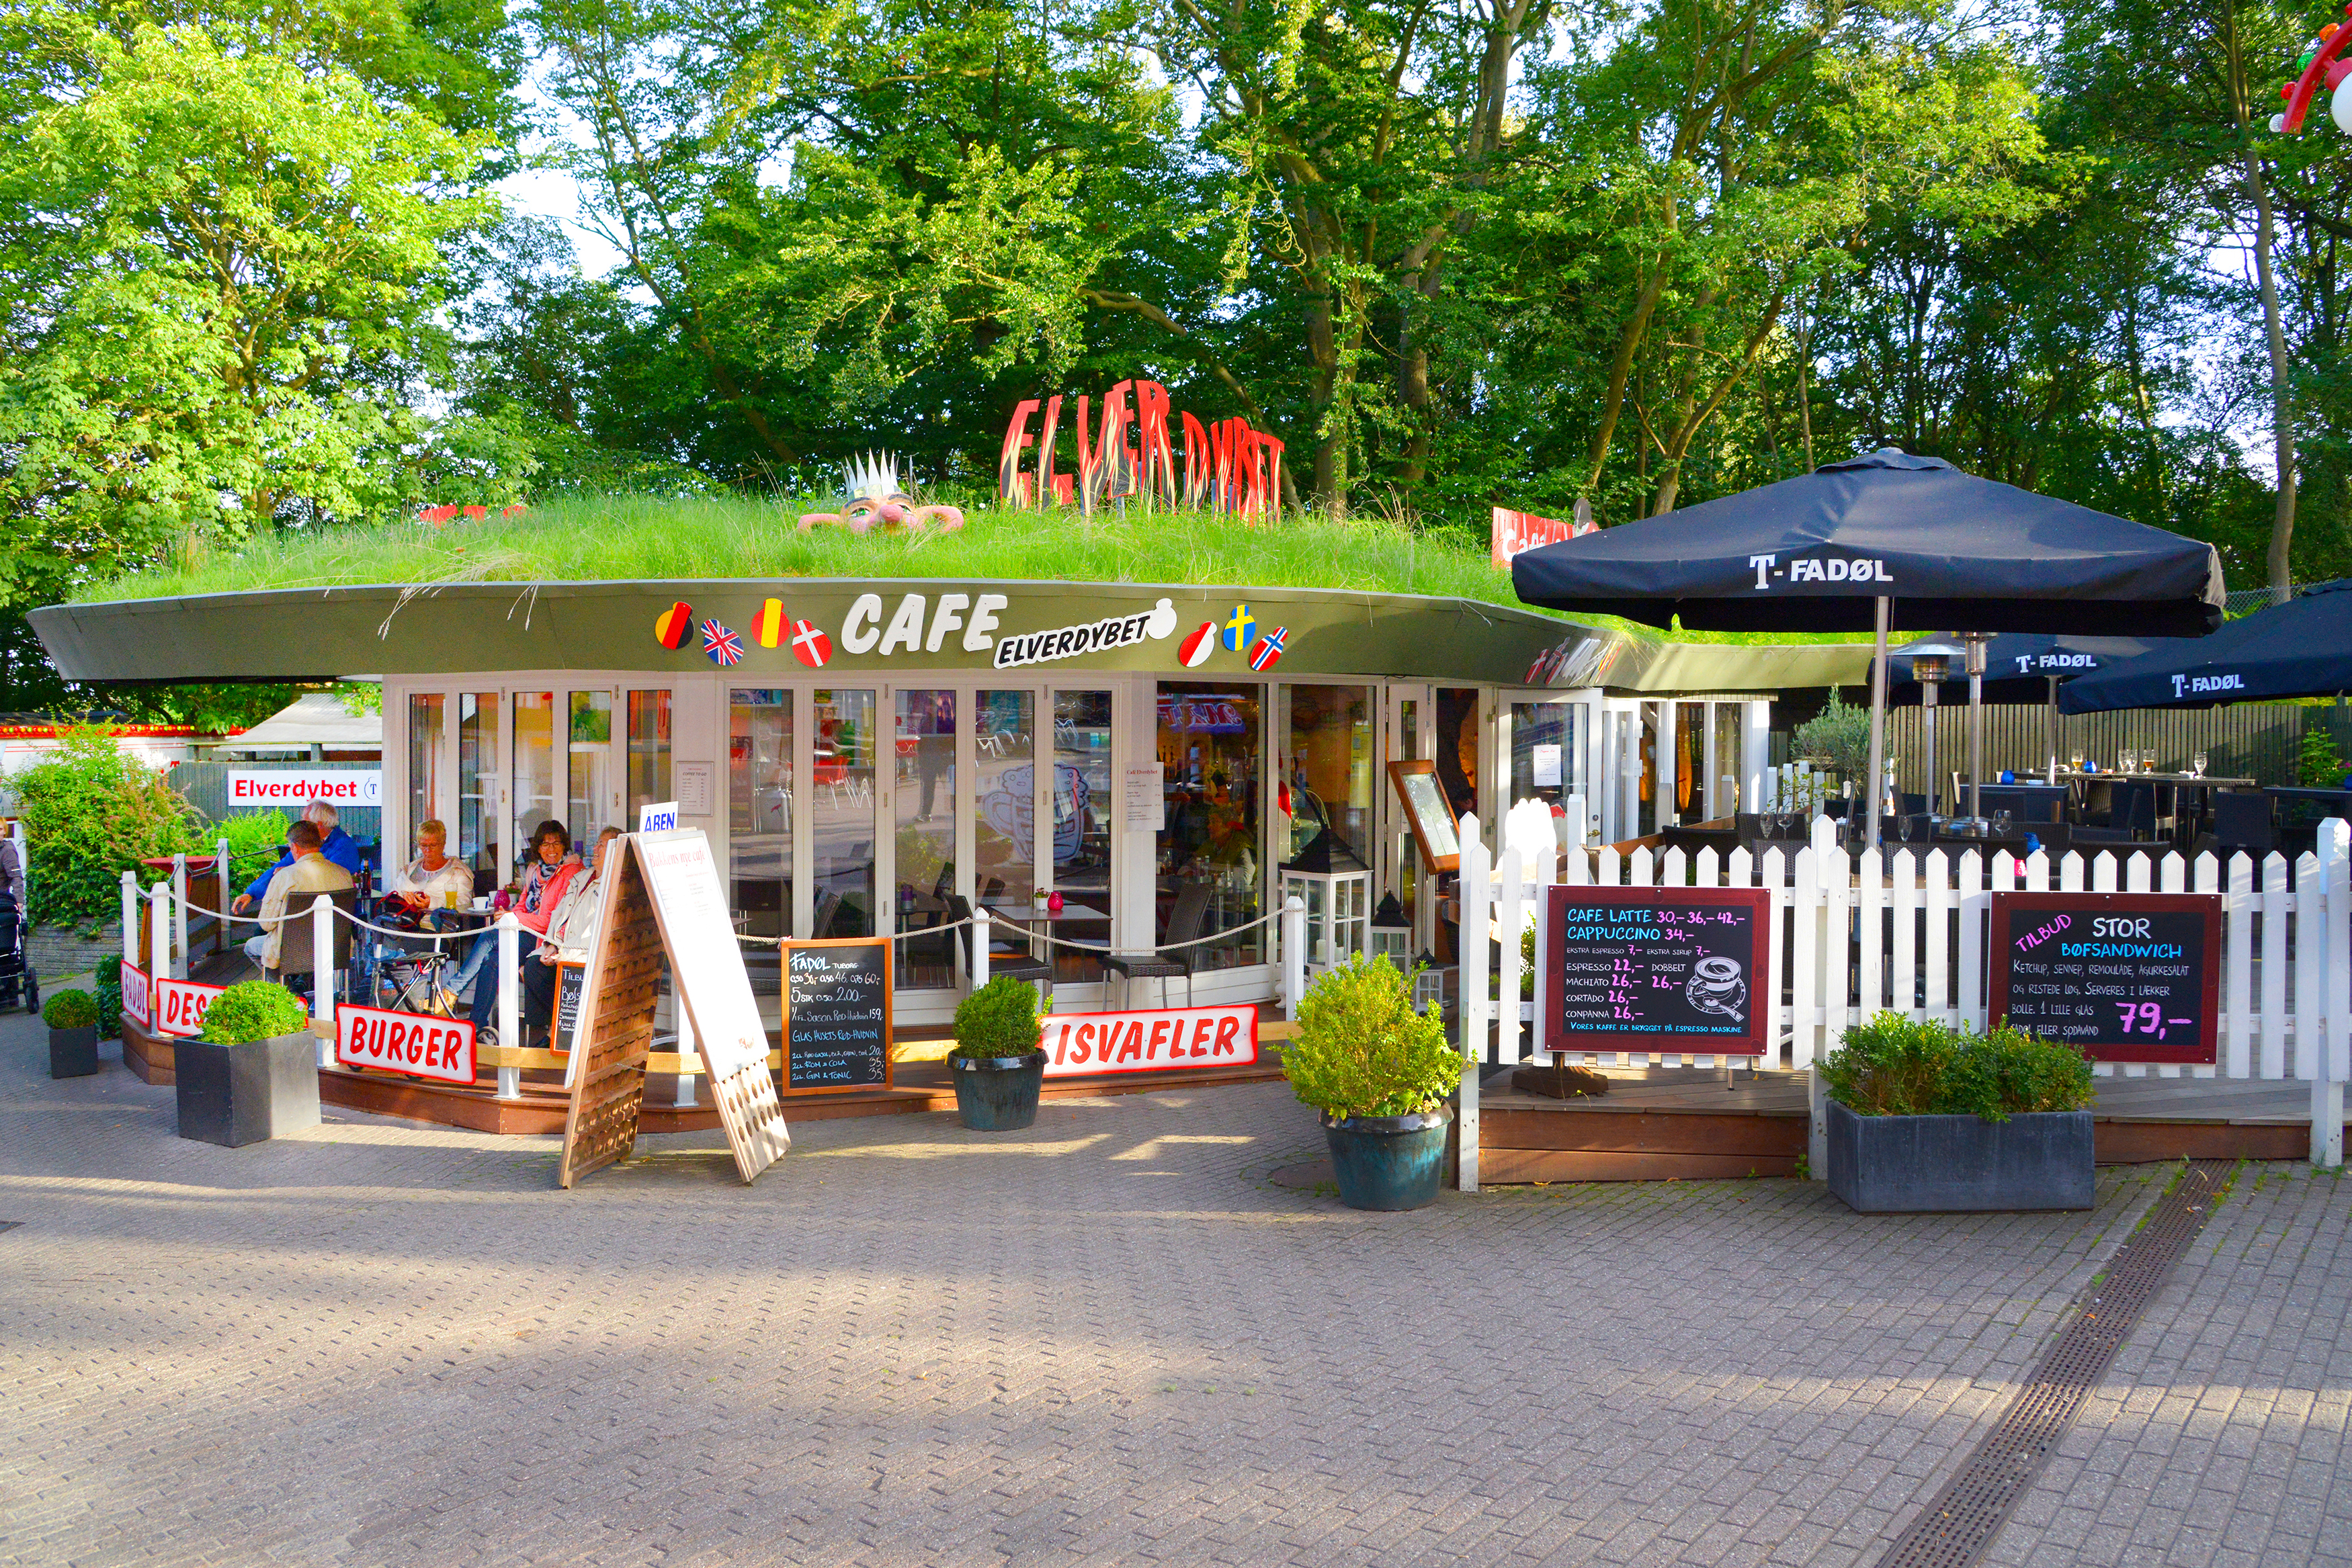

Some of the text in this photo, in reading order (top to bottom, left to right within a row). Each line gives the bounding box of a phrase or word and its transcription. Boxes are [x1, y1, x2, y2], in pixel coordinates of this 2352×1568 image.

[841, 593, 1008, 656] CAFE
[998, 614, 1150, 664] ELVERDYBET
[235, 779, 357, 801] Elverdybet
[644, 809, 675, 833] ÅBEN
[648, 851, 679, 868] Bakkens
[1567, 908, 1604, 922] CAFE
[1609, 909, 1652, 923] LATTE
[1567, 926, 1661, 941] CAPPUCCINO
[2015, 914, 2072, 952] TILBUD
[2093, 917, 2151, 939] STOR
[2061, 942, 2182, 959] BØFSANDWICH
[1566, 963, 1611, 972] ESPRESSO
[1651, 963, 1686, 972] DOBBELT
[2138, 965, 2189, 976] AGURKESALAT
[1566, 978, 1609, 987] MACHIATO
[2013, 984, 2024, 994] OG
[2028, 984, 2060, 994] RISTEDE
[2085, 982, 2125, 996] SERVERES
[2139, 985, 2170, 996] LÆKKER
[125, 971, 146, 1015] FADØL
[790, 986, 801, 1003] 5
[1566, 994, 1604, 1002] CORTADO
[1566, 1010, 1610, 1019] CONPANNA
[2040, 1001, 2046, 1014] 1
[2050, 1004, 2070, 1014] LILLE
[2075, 1004, 2094, 1016] GLAS
[1570, 1021, 1594, 1031] VORES
[1665, 1023, 1673, 1032] PÅ
[2037, 1025, 2058, 1035] ELLER
[2062, 1025, 2099, 1036] SODAVAND
[349, 1016, 462, 1071] BURGER
[792, 1029, 812, 1043] GLAS
[1054, 1016, 1240, 1065] ISVAFLER
[828, 1059, 848, 1068] COLA
[806, 1070, 821, 1080] GIN
[828, 1070, 852, 1080] TONIC
